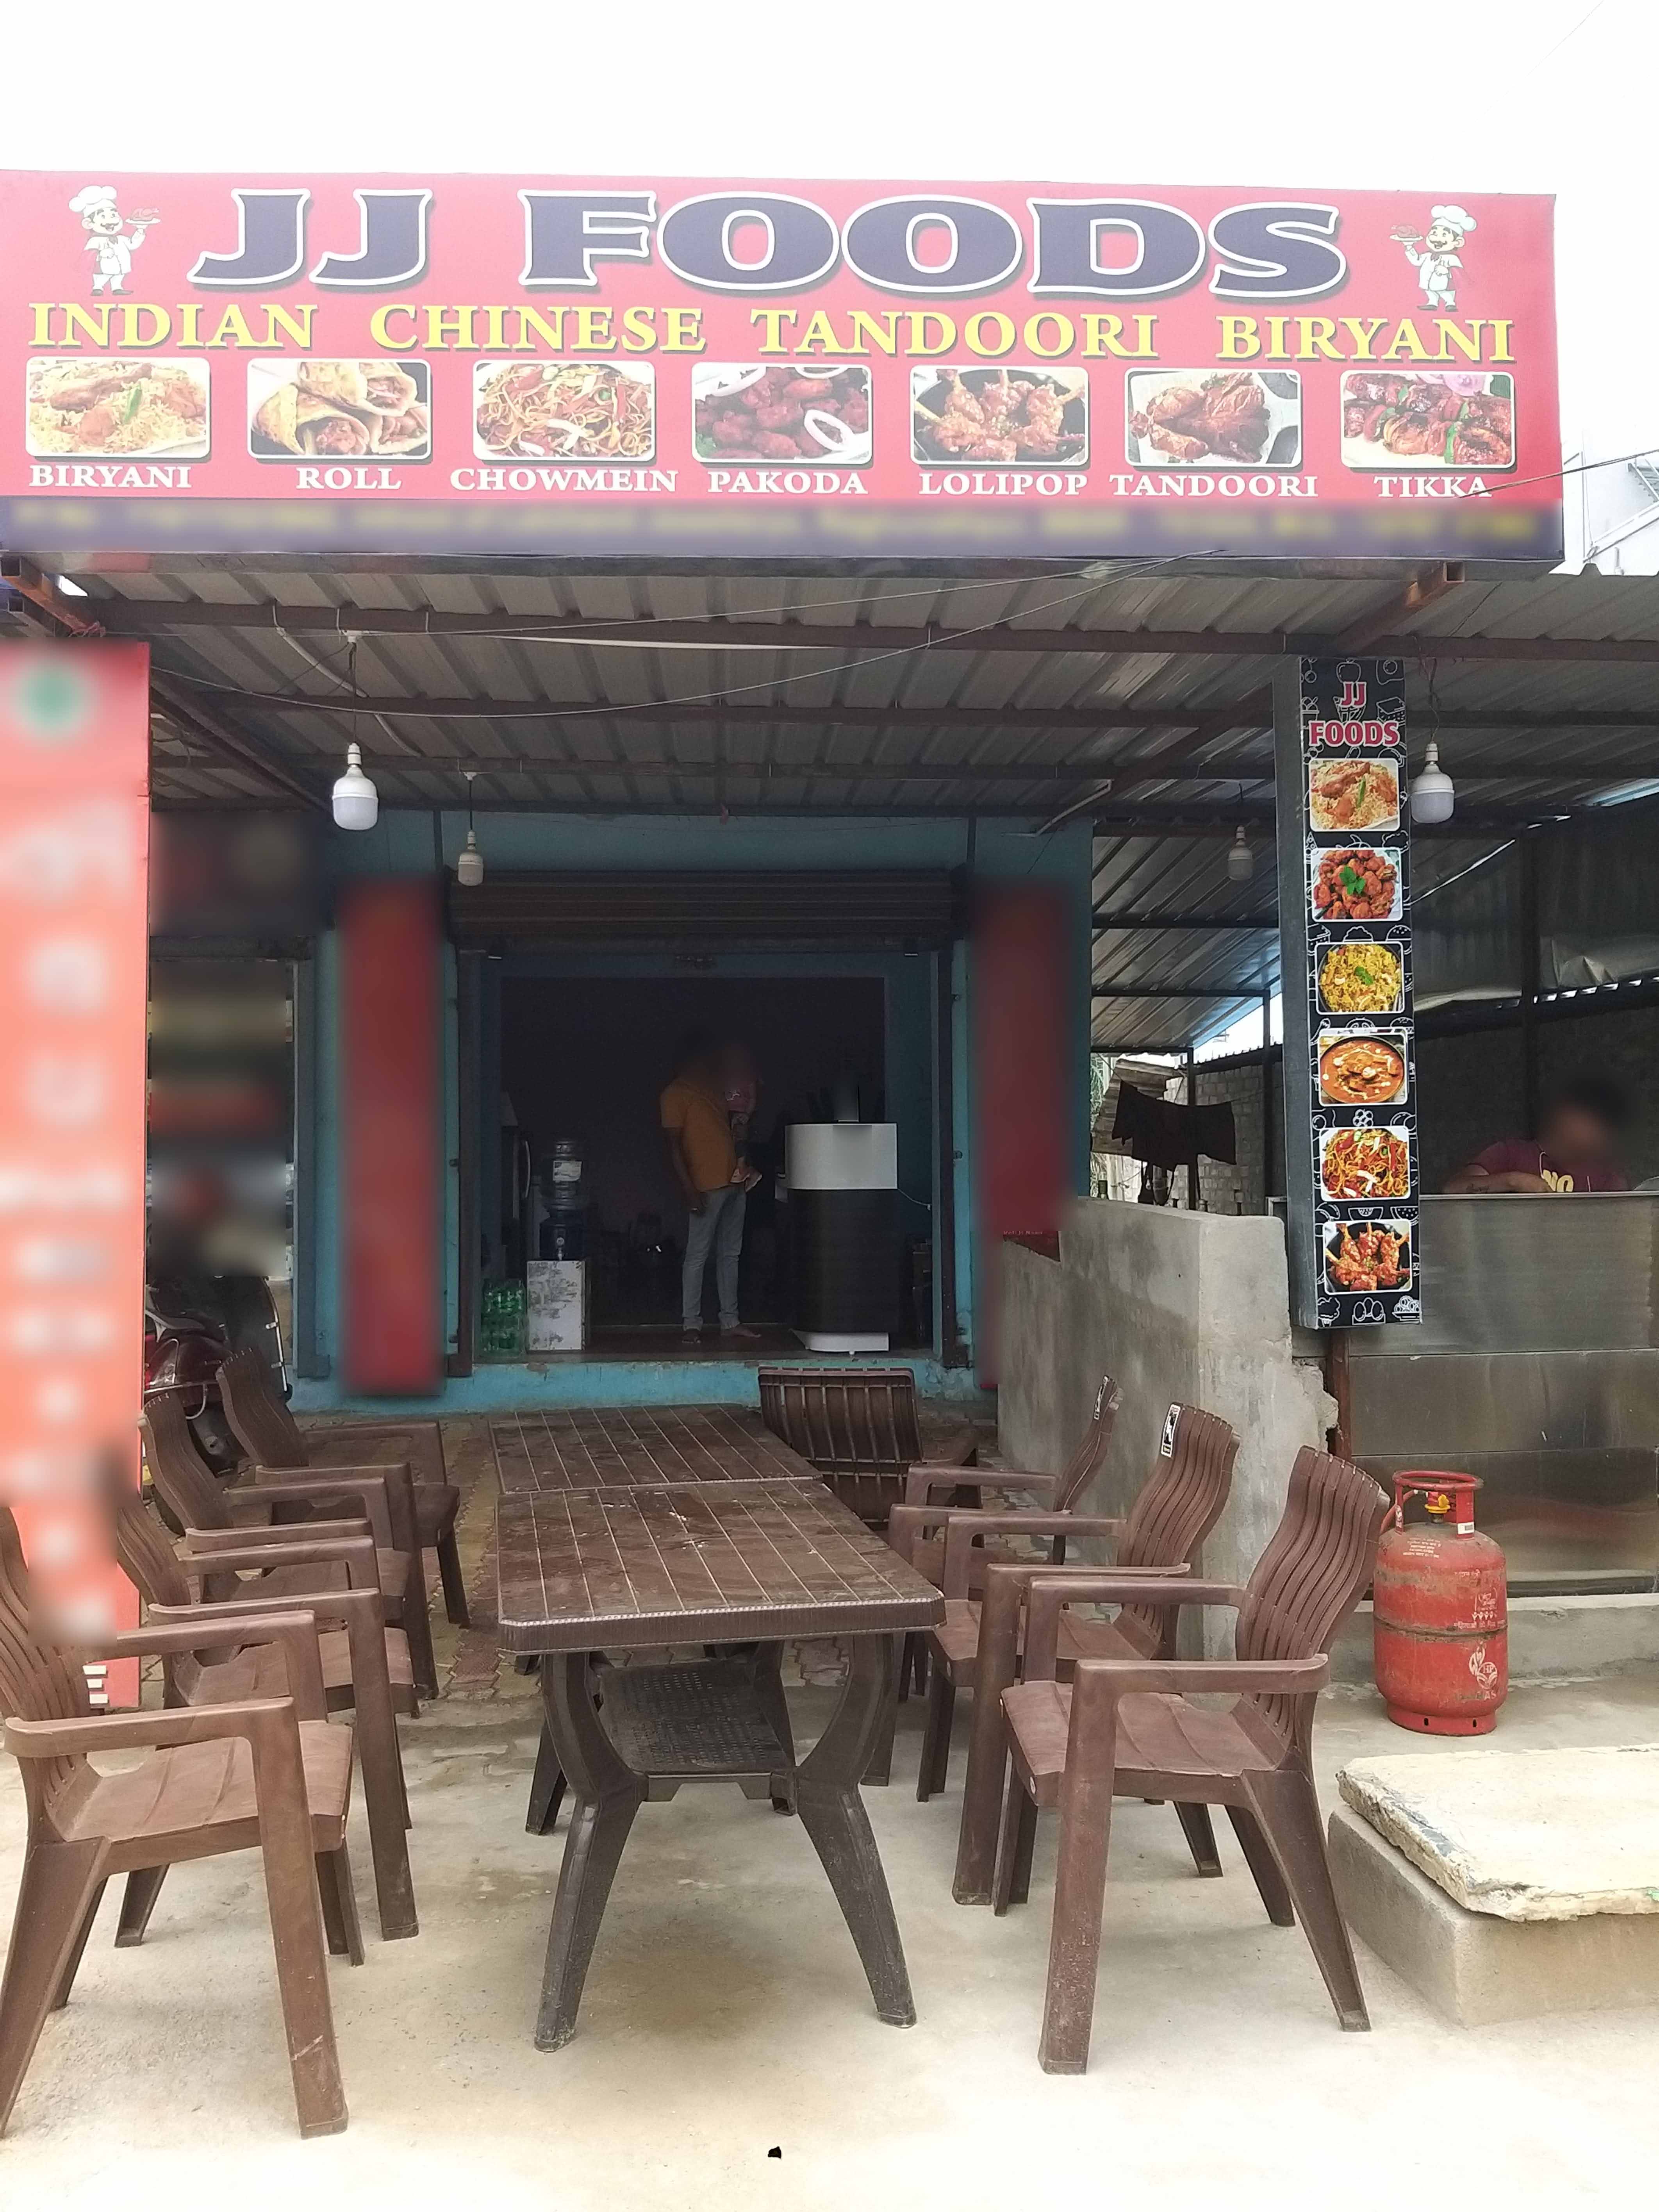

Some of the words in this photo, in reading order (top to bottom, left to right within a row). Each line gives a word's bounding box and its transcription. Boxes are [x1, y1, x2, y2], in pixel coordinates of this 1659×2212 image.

[188, 189, 432, 286] JJ
[518, 189, 1347, 298] FOODS
[30, 302, 316, 349] INDIAN
[369, 304, 706, 352] CHINESE
[751, 309, 1158, 358] TANDOORI
[1217, 315, 1514, 362] BIRYANI
[29, 464, 192, 488] BIRYANI
[296, 466, 402, 491] ROLL
[450, 466, 679, 492] CHOWMEIN
[707, 468, 869, 494] PAKODA
[919, 471, 1088, 496] LOLIPOP
[1109, 474, 1318, 498] TANDOORI
[1373, 476, 1492, 498] TIKKA
[1340, 681, 1366, 707] JJ
[1309, 720, 1400, 747] FOODS
